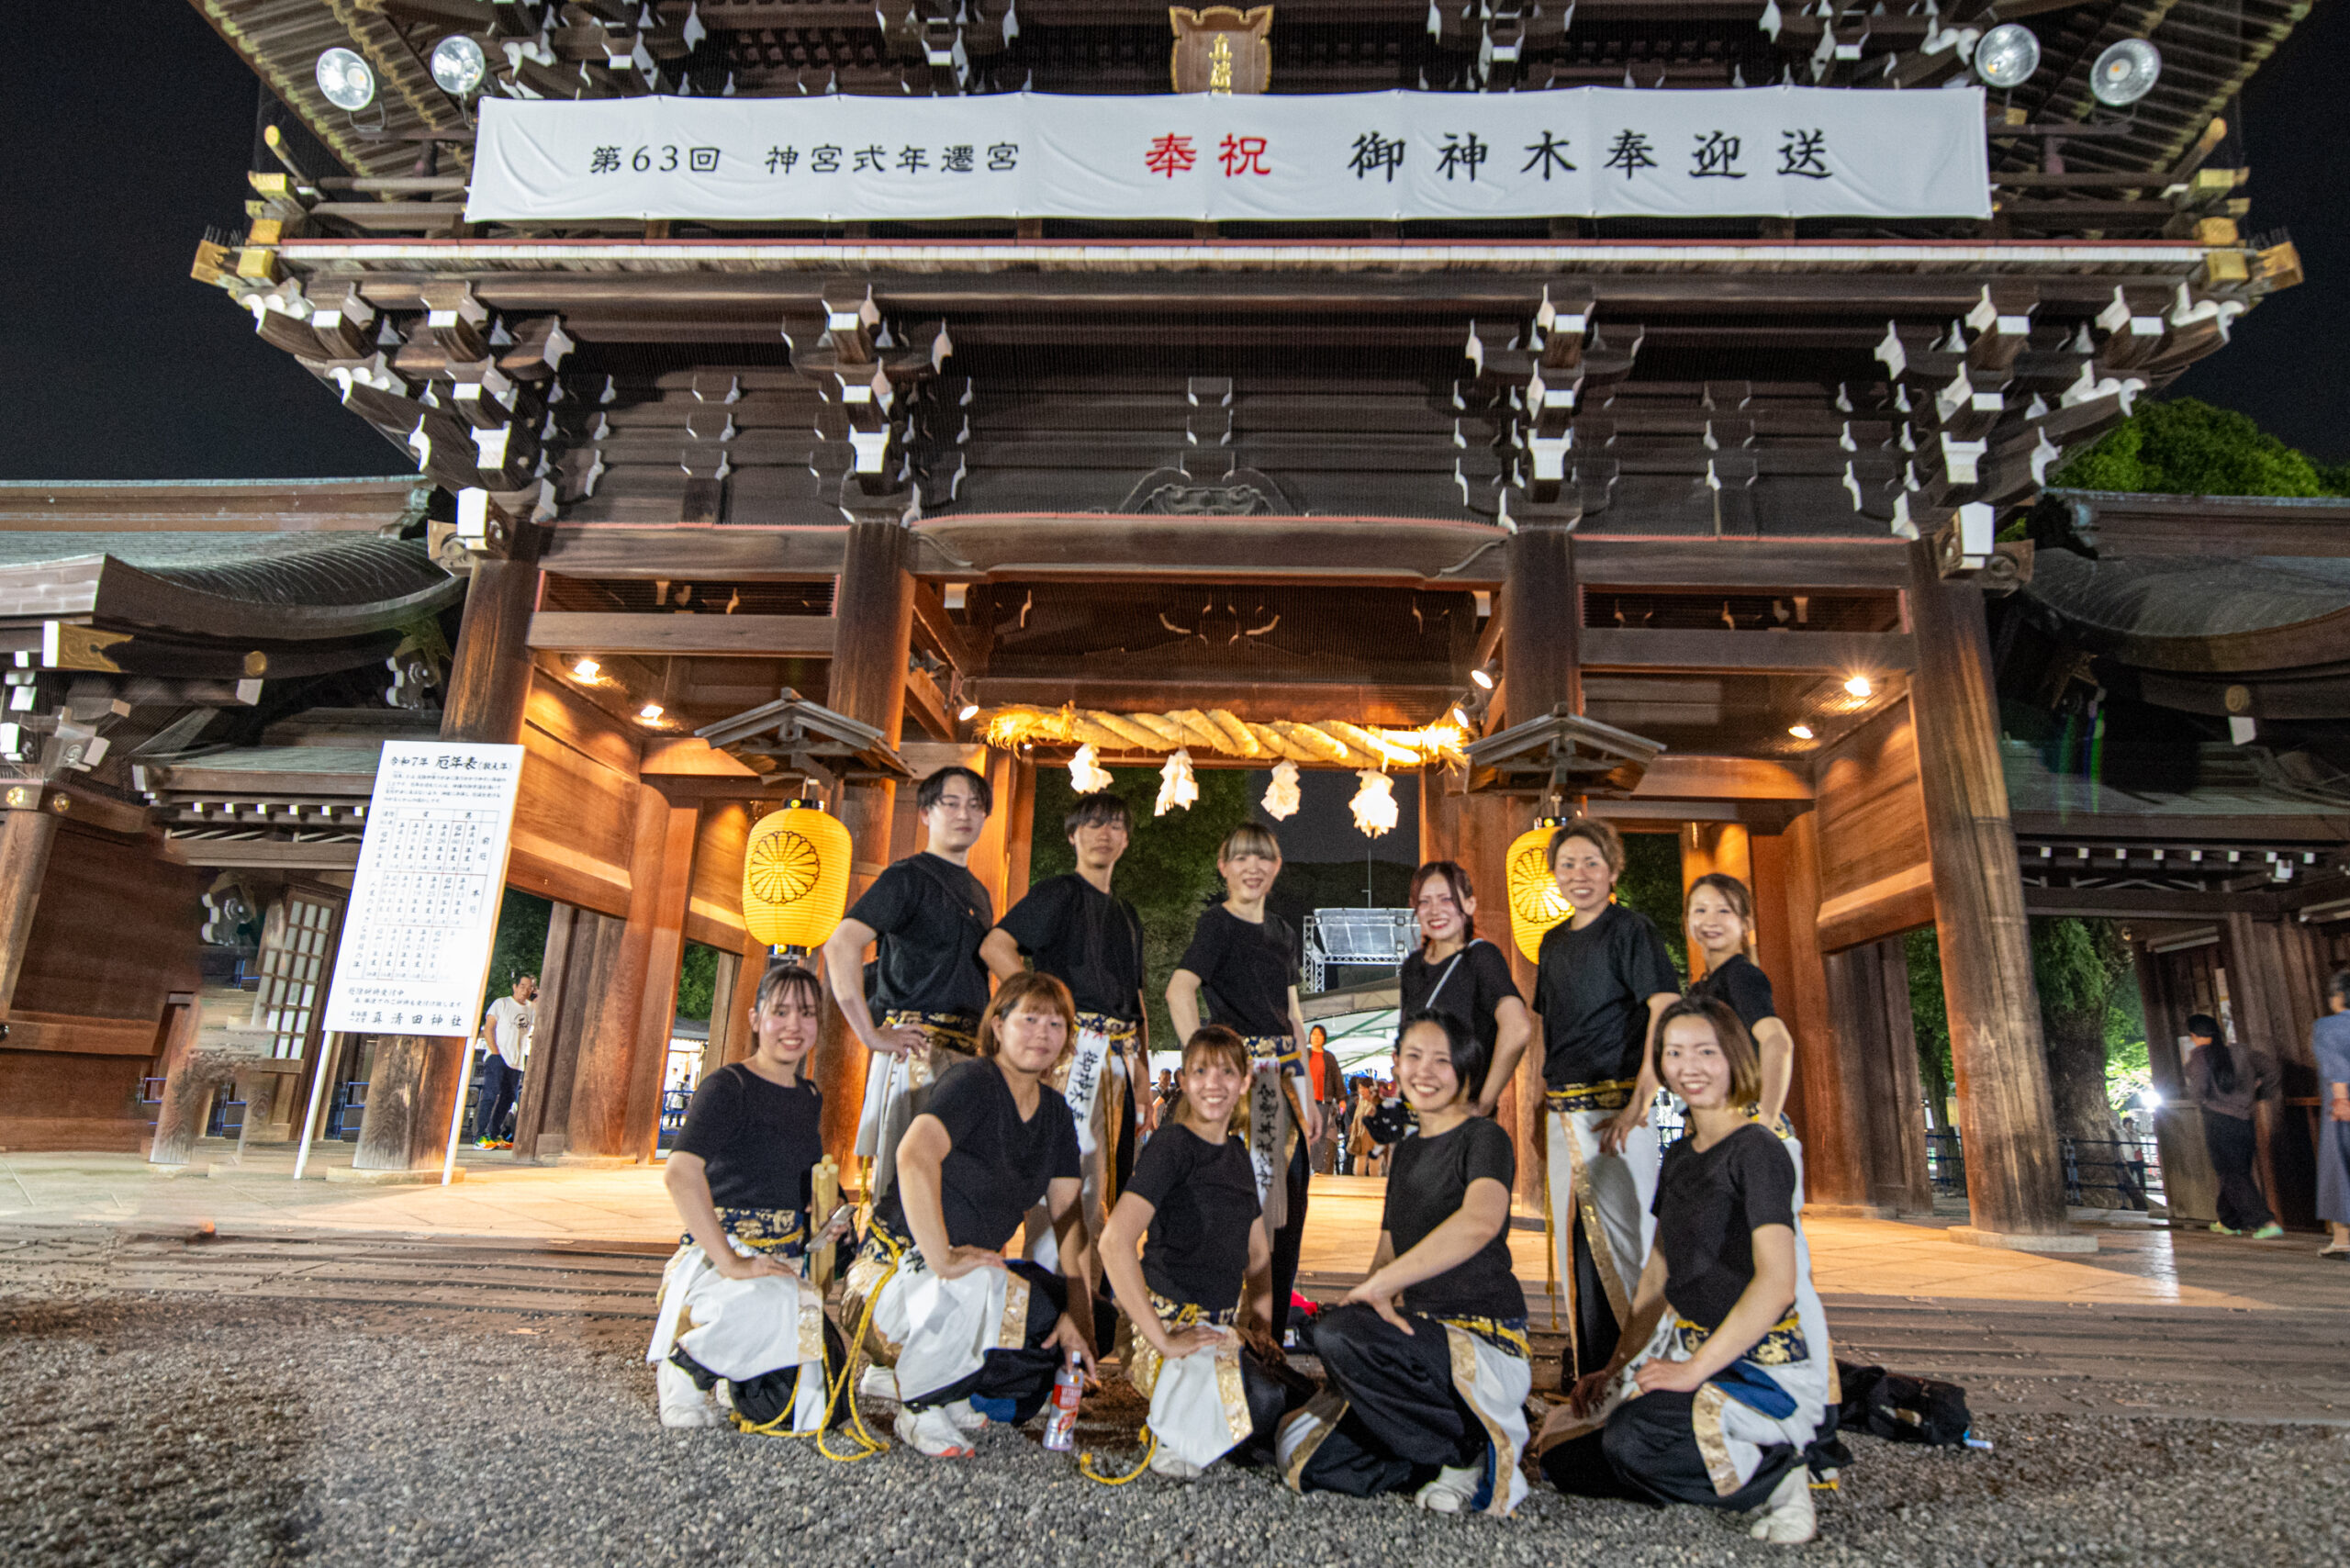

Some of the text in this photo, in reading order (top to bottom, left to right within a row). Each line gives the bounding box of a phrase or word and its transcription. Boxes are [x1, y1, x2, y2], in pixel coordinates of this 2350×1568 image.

[590, 129, 1832, 182] 第63回 神宮式年遷宮 奉祝 御神木奉迎送
[390, 756, 429, 767] 令和7年
[372, 1011, 462, 1026] 真清田神社
